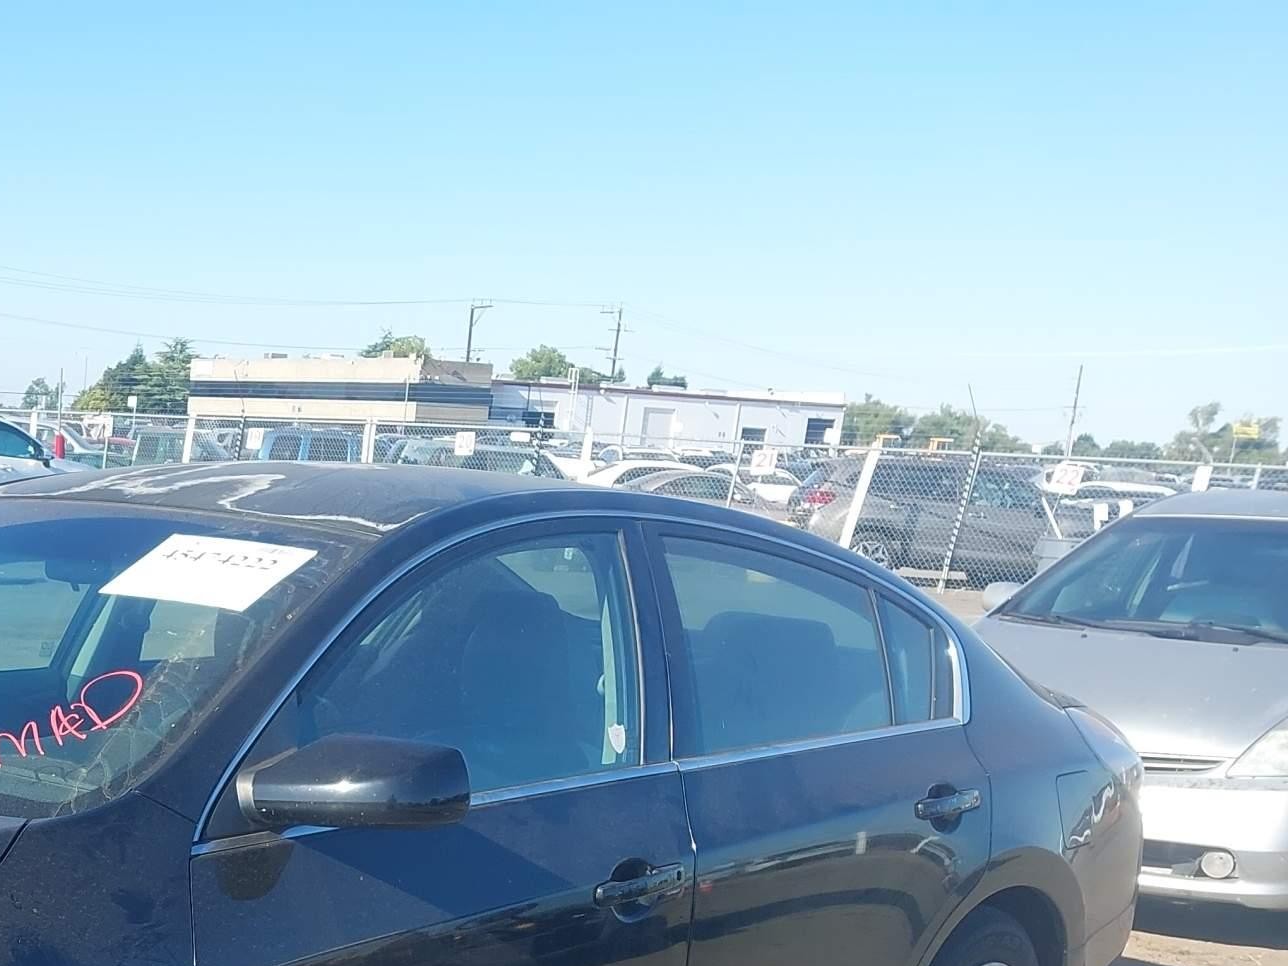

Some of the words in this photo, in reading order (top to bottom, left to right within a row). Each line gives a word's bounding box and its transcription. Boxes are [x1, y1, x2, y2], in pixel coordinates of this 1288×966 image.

[458, 434, 473, 449] 20
[754, 452, 774, 467] 21
[1055, 468, 1079, 486] 22
